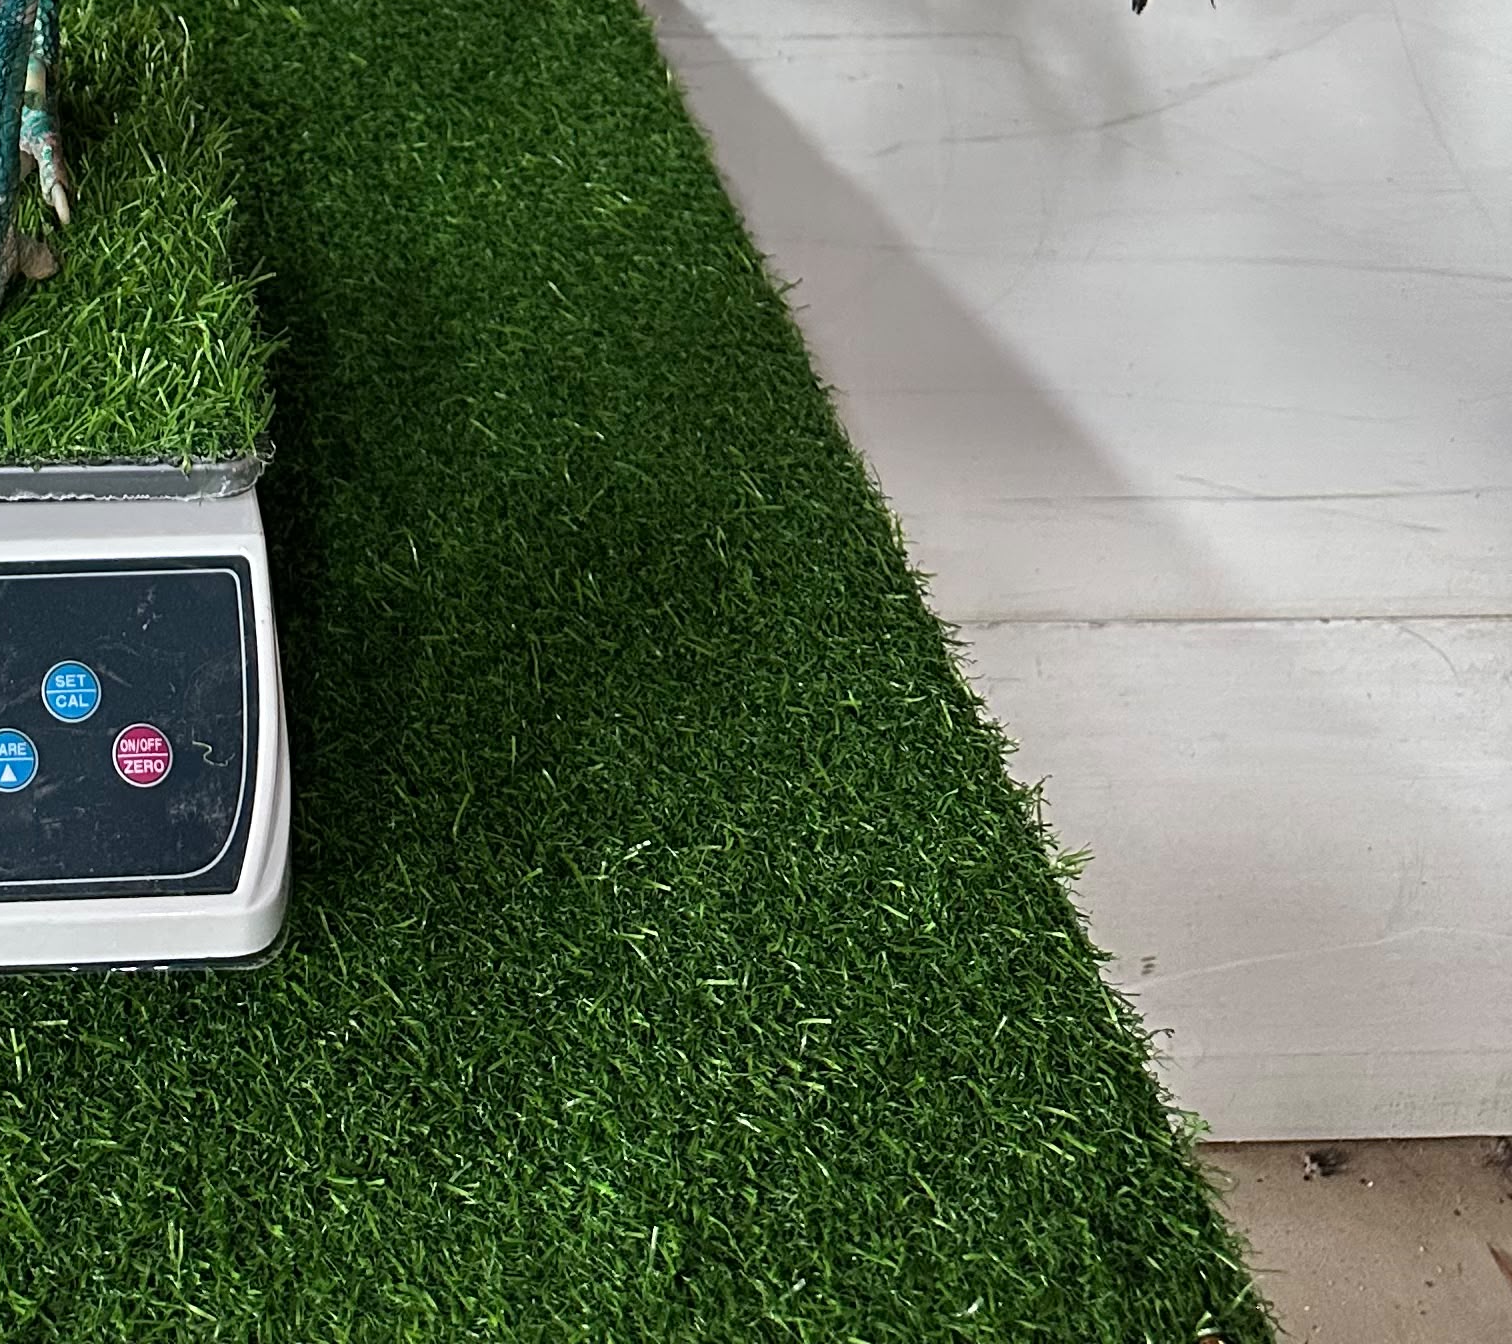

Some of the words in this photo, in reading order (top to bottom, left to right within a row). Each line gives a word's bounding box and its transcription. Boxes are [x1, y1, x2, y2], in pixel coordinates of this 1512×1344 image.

[54, 674, 86, 689] SET
[55, 693, 90, 709] CAL
[119, 737, 163, 754] ON/OFF
[124, 758, 165, 775] ZERO
